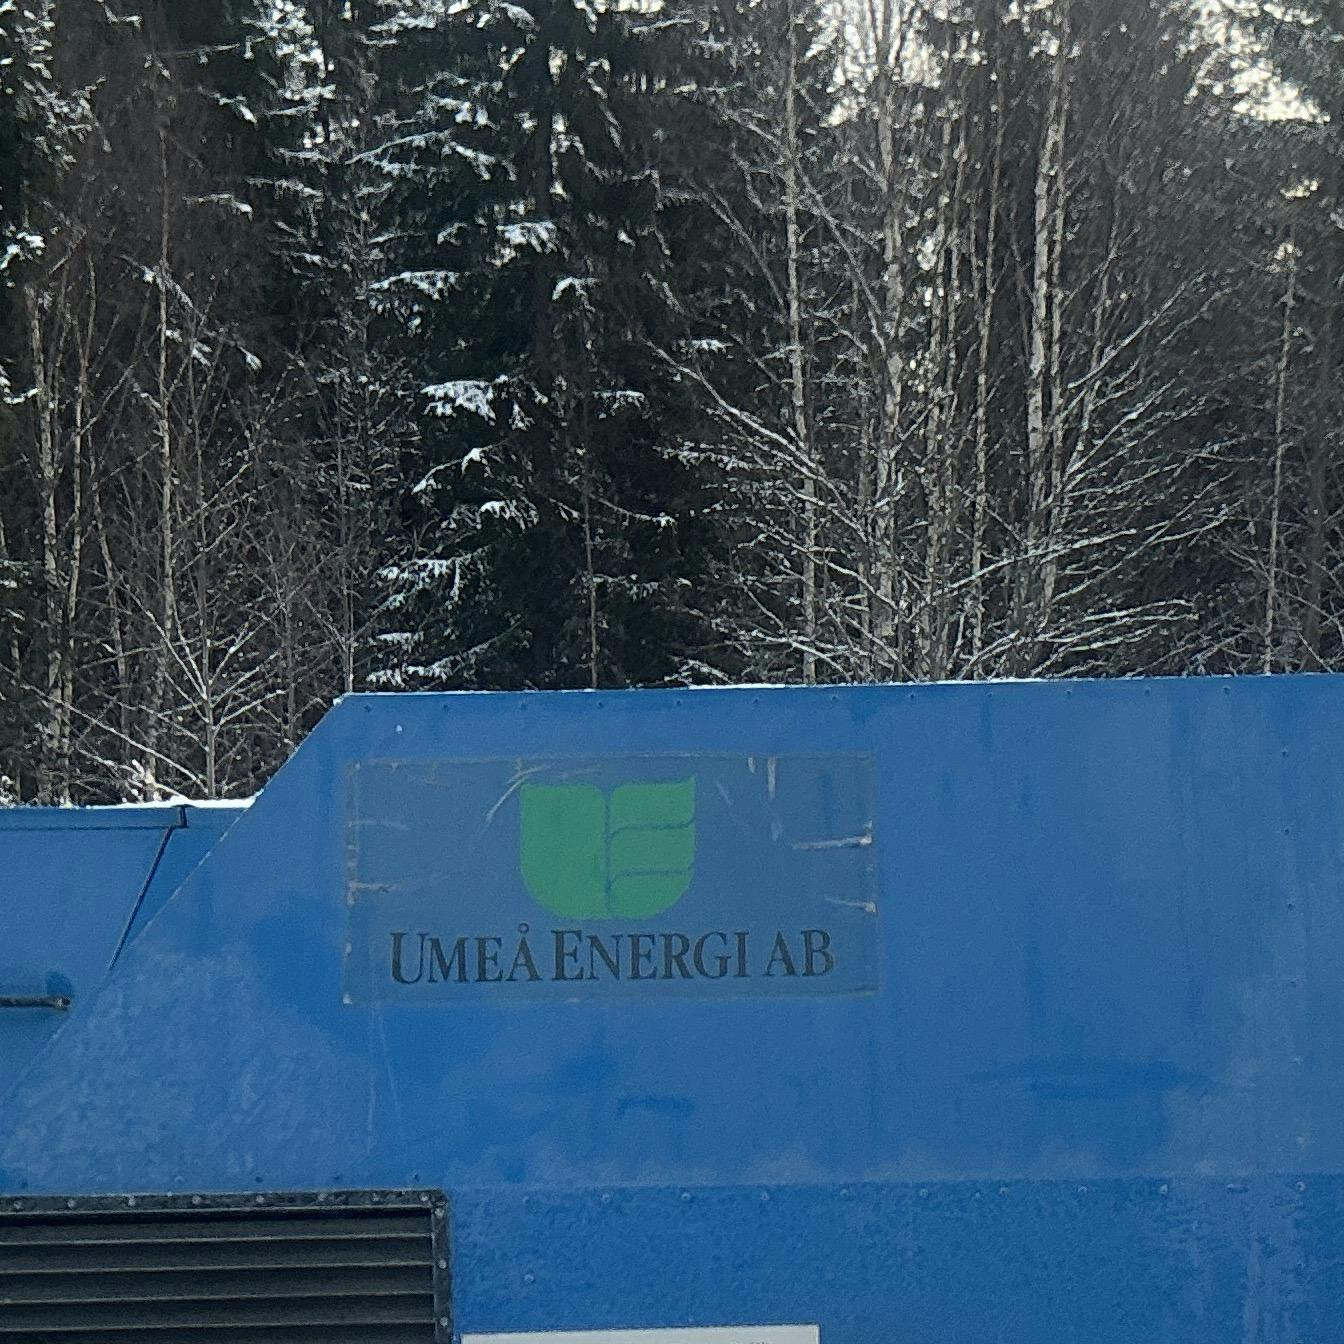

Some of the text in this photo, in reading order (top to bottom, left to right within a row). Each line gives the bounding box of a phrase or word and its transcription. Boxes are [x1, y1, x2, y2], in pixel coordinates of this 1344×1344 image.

[390, 922, 834, 984] UMEÅ ENERGI AB
